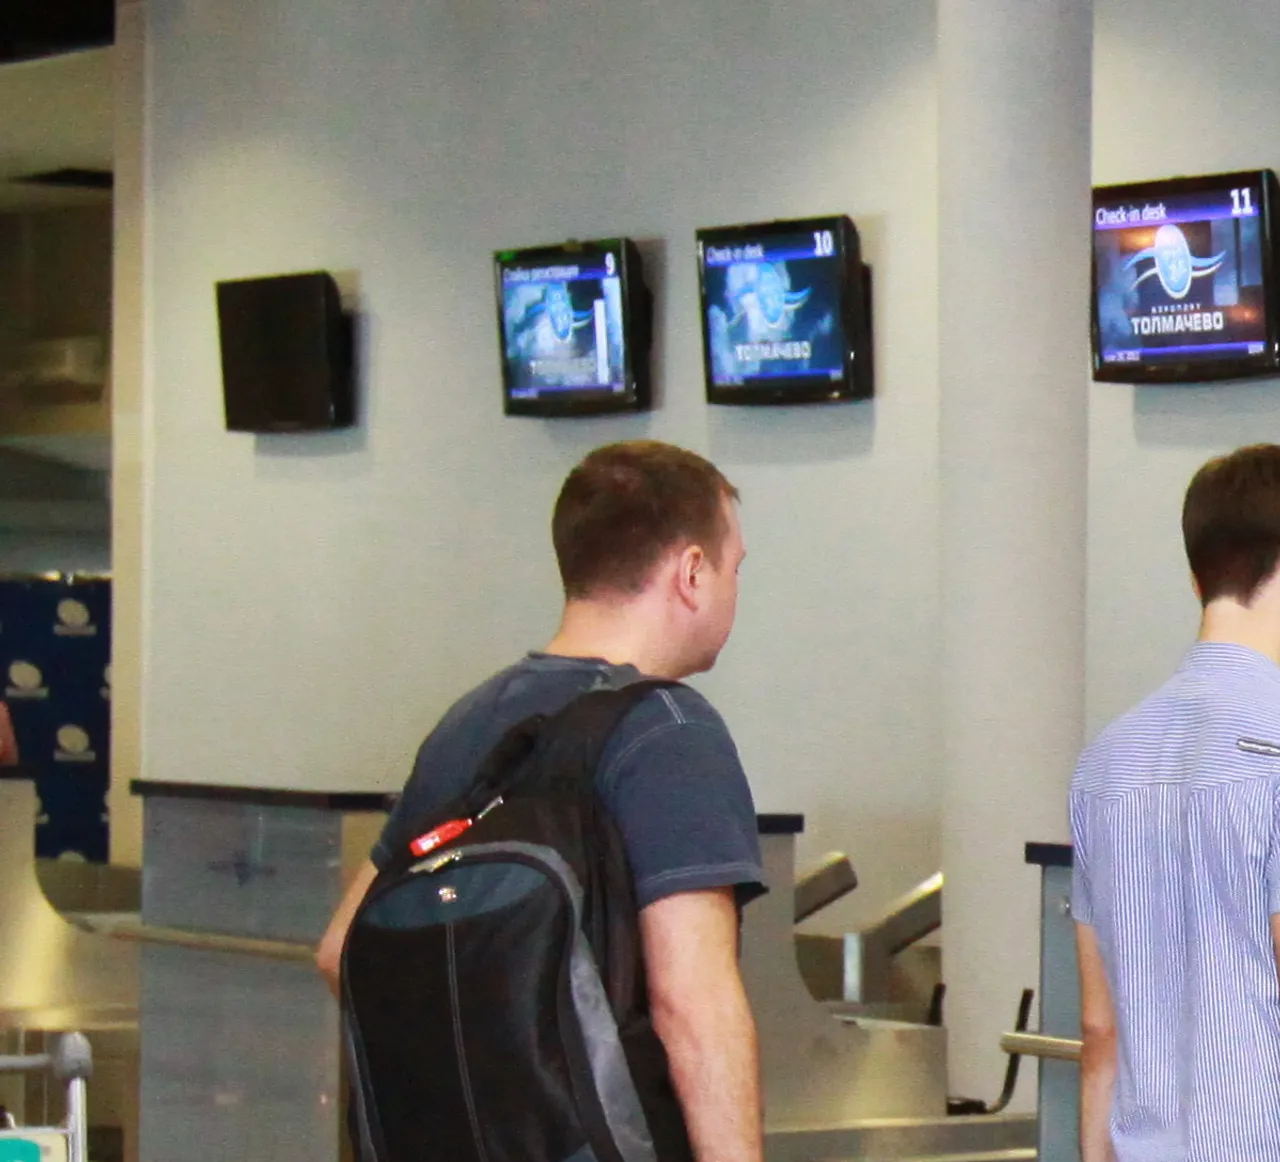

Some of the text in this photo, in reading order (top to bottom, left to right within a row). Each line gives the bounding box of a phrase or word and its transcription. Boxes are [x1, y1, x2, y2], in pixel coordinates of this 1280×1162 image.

[1096, 202, 1167, 225] Check-in desk
[1230, 191, 1253, 215] 11
[813, 230, 835, 257] 10
[605, 251, 616, 277] 9
[1131, 311, 1224, 336] ТОЛМАЧЕВО
